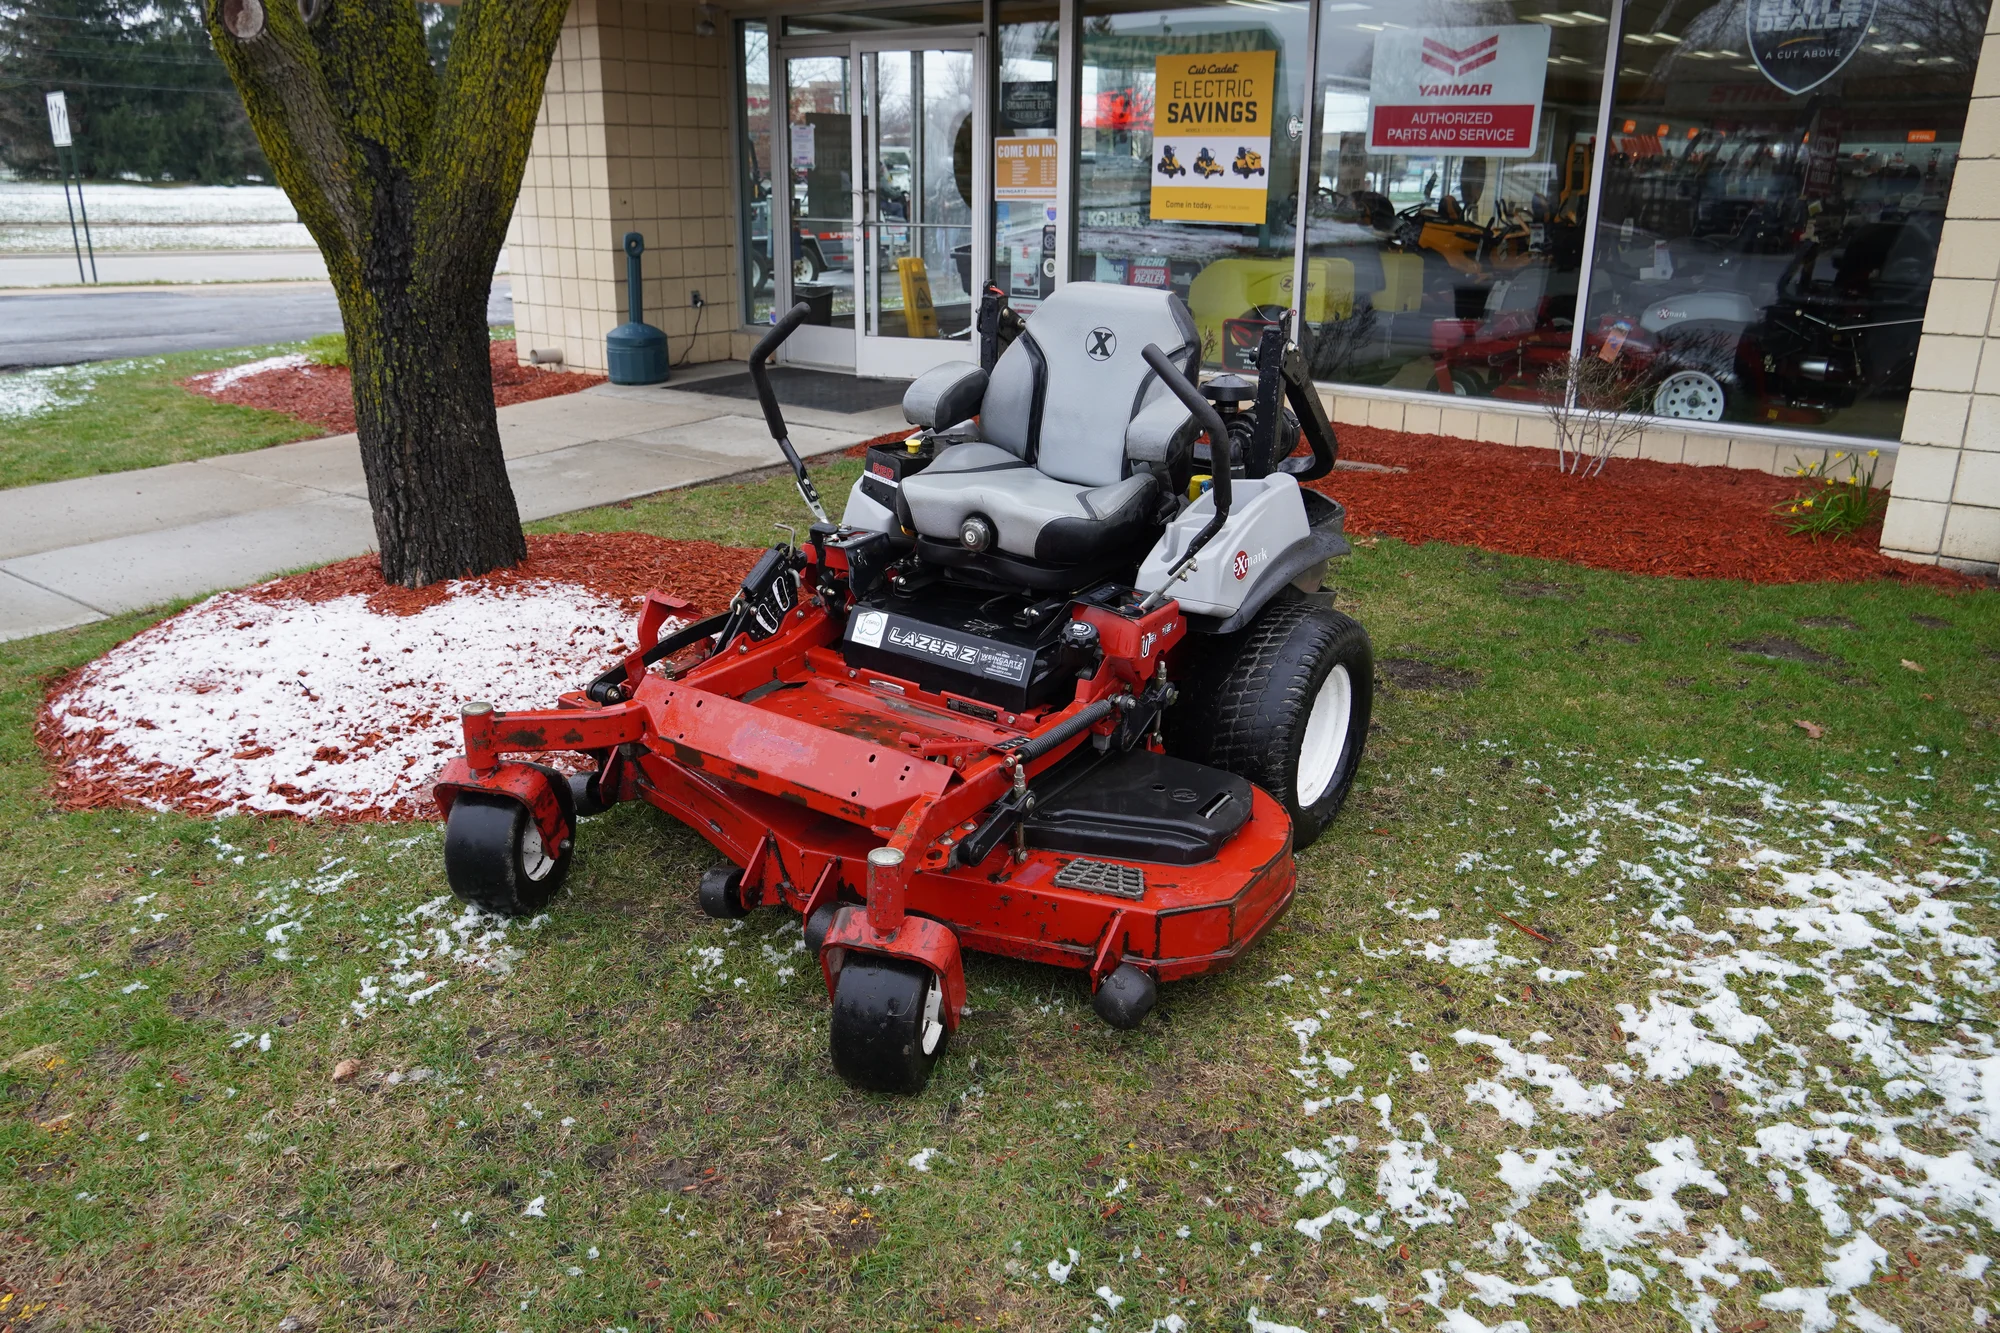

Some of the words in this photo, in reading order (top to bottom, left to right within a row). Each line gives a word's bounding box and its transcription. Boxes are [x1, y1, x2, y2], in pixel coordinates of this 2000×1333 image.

[1756, 13, 1861, 32] DEALER
[1765, 52, 1773, 60] A
[1777, 51, 1798, 60] CUT
[1803, 49, 1841, 58] ABOVE
[1188, 64, 1206, 75] Cub
[1207, 63, 1239, 74] Cadet
[1173, 79, 1253, 98] ELECTRIC
[1419, 84, 1493, 97] YANMAR
[1007, 101, 1037, 110] SIGNATURE
[1037, 100, 1052, 110] ELITE
[1167, 101, 1257, 123] SAVINGS
[1411, 112, 1493, 125] AUTHORIZED
[1387, 129, 1427, 141] PARTS
[1430, 129, 1456, 140] AND
[1459, 129, 1515, 141] SERVICE
[998, 145, 1024, 158] COME
[1026, 145, 1040, 157] ON
[1042, 144, 1056, 157] IN!
[1165, 200, 1184, 209] Come
[1186, 201, 1192, 209] in
[1193, 201, 1212, 210] today.
[1087, 211, 1141, 228] KOHLER
[1139, 257, 1166, 267] ECHO
[1134, 274, 1166, 284] DEALER
[1089, 331, 1112, 356] X
[872, 462, 894, 480] RED
[888, 628, 959, 659] LAZER
[958, 647, 978, 663] Z
